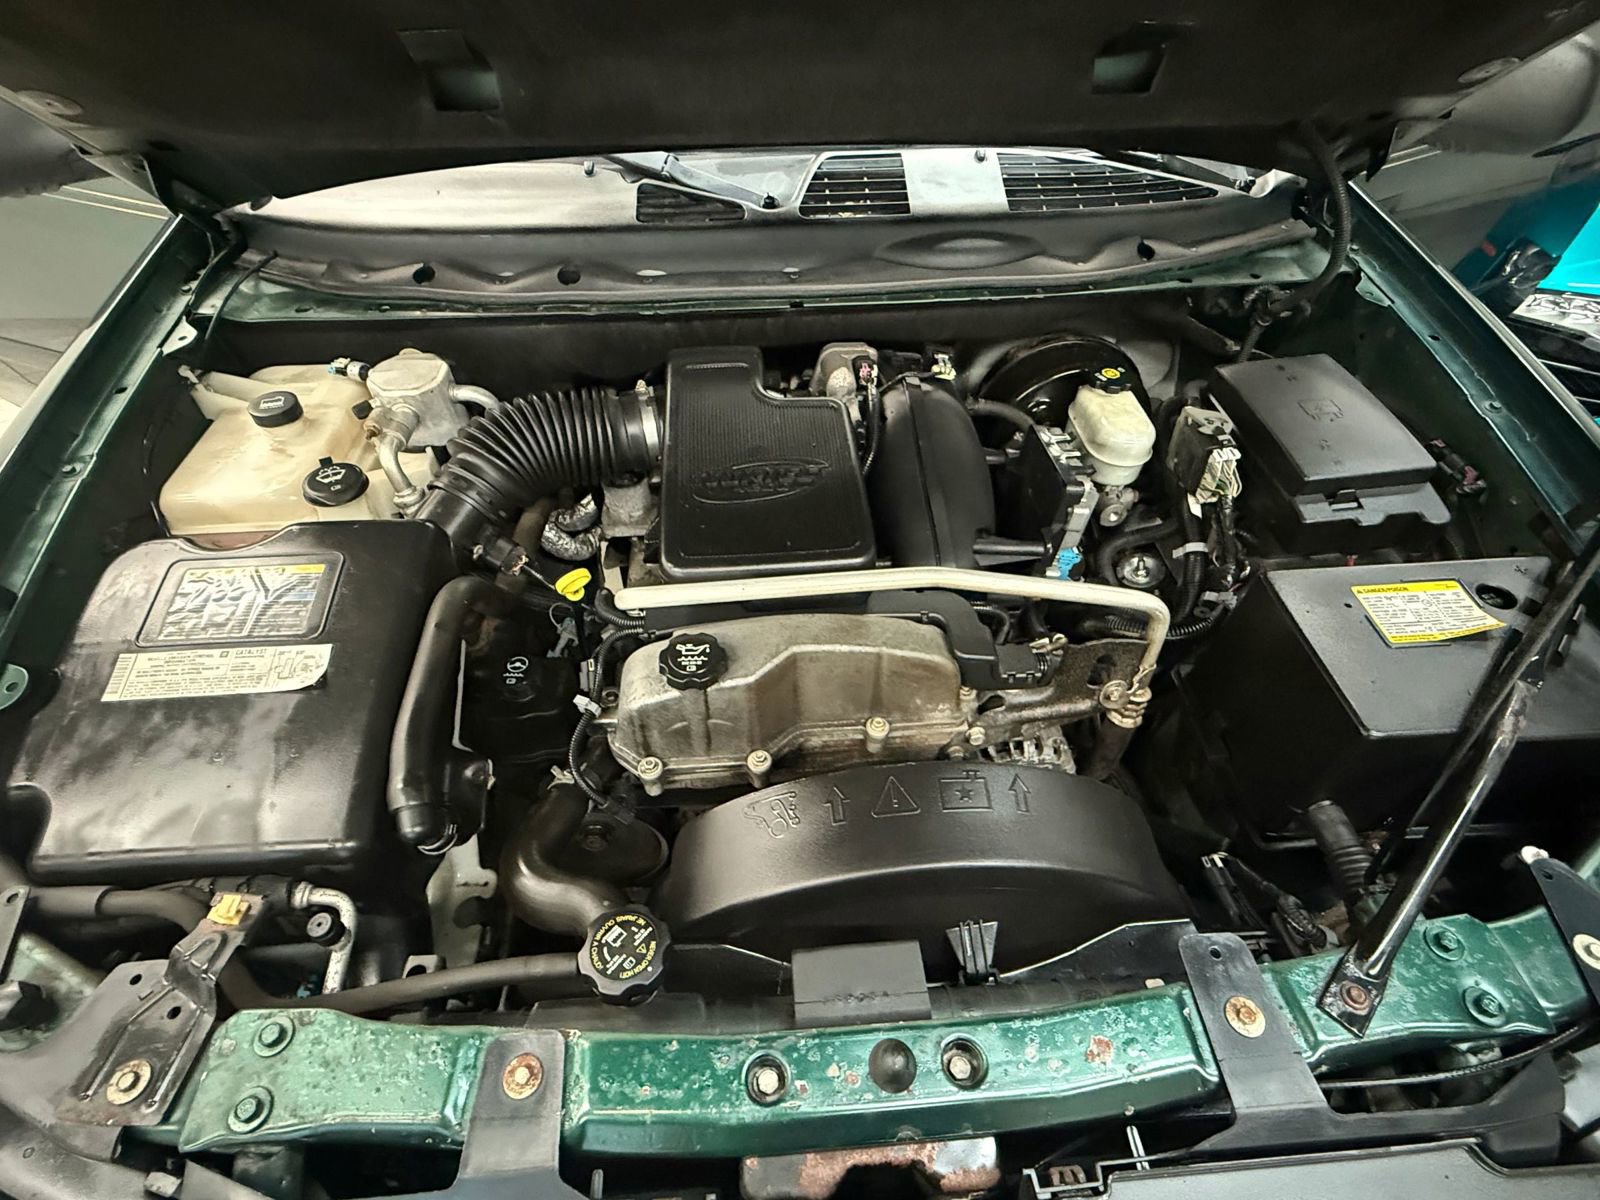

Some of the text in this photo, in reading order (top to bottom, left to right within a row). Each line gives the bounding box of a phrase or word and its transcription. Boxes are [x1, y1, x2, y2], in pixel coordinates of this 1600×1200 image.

[235, 648, 267, 656] CATALYST
[594, 920, 615, 940] OUVRIR
[645, 940, 657, 961] NEVER
[634, 960, 649, 974] OPEN
